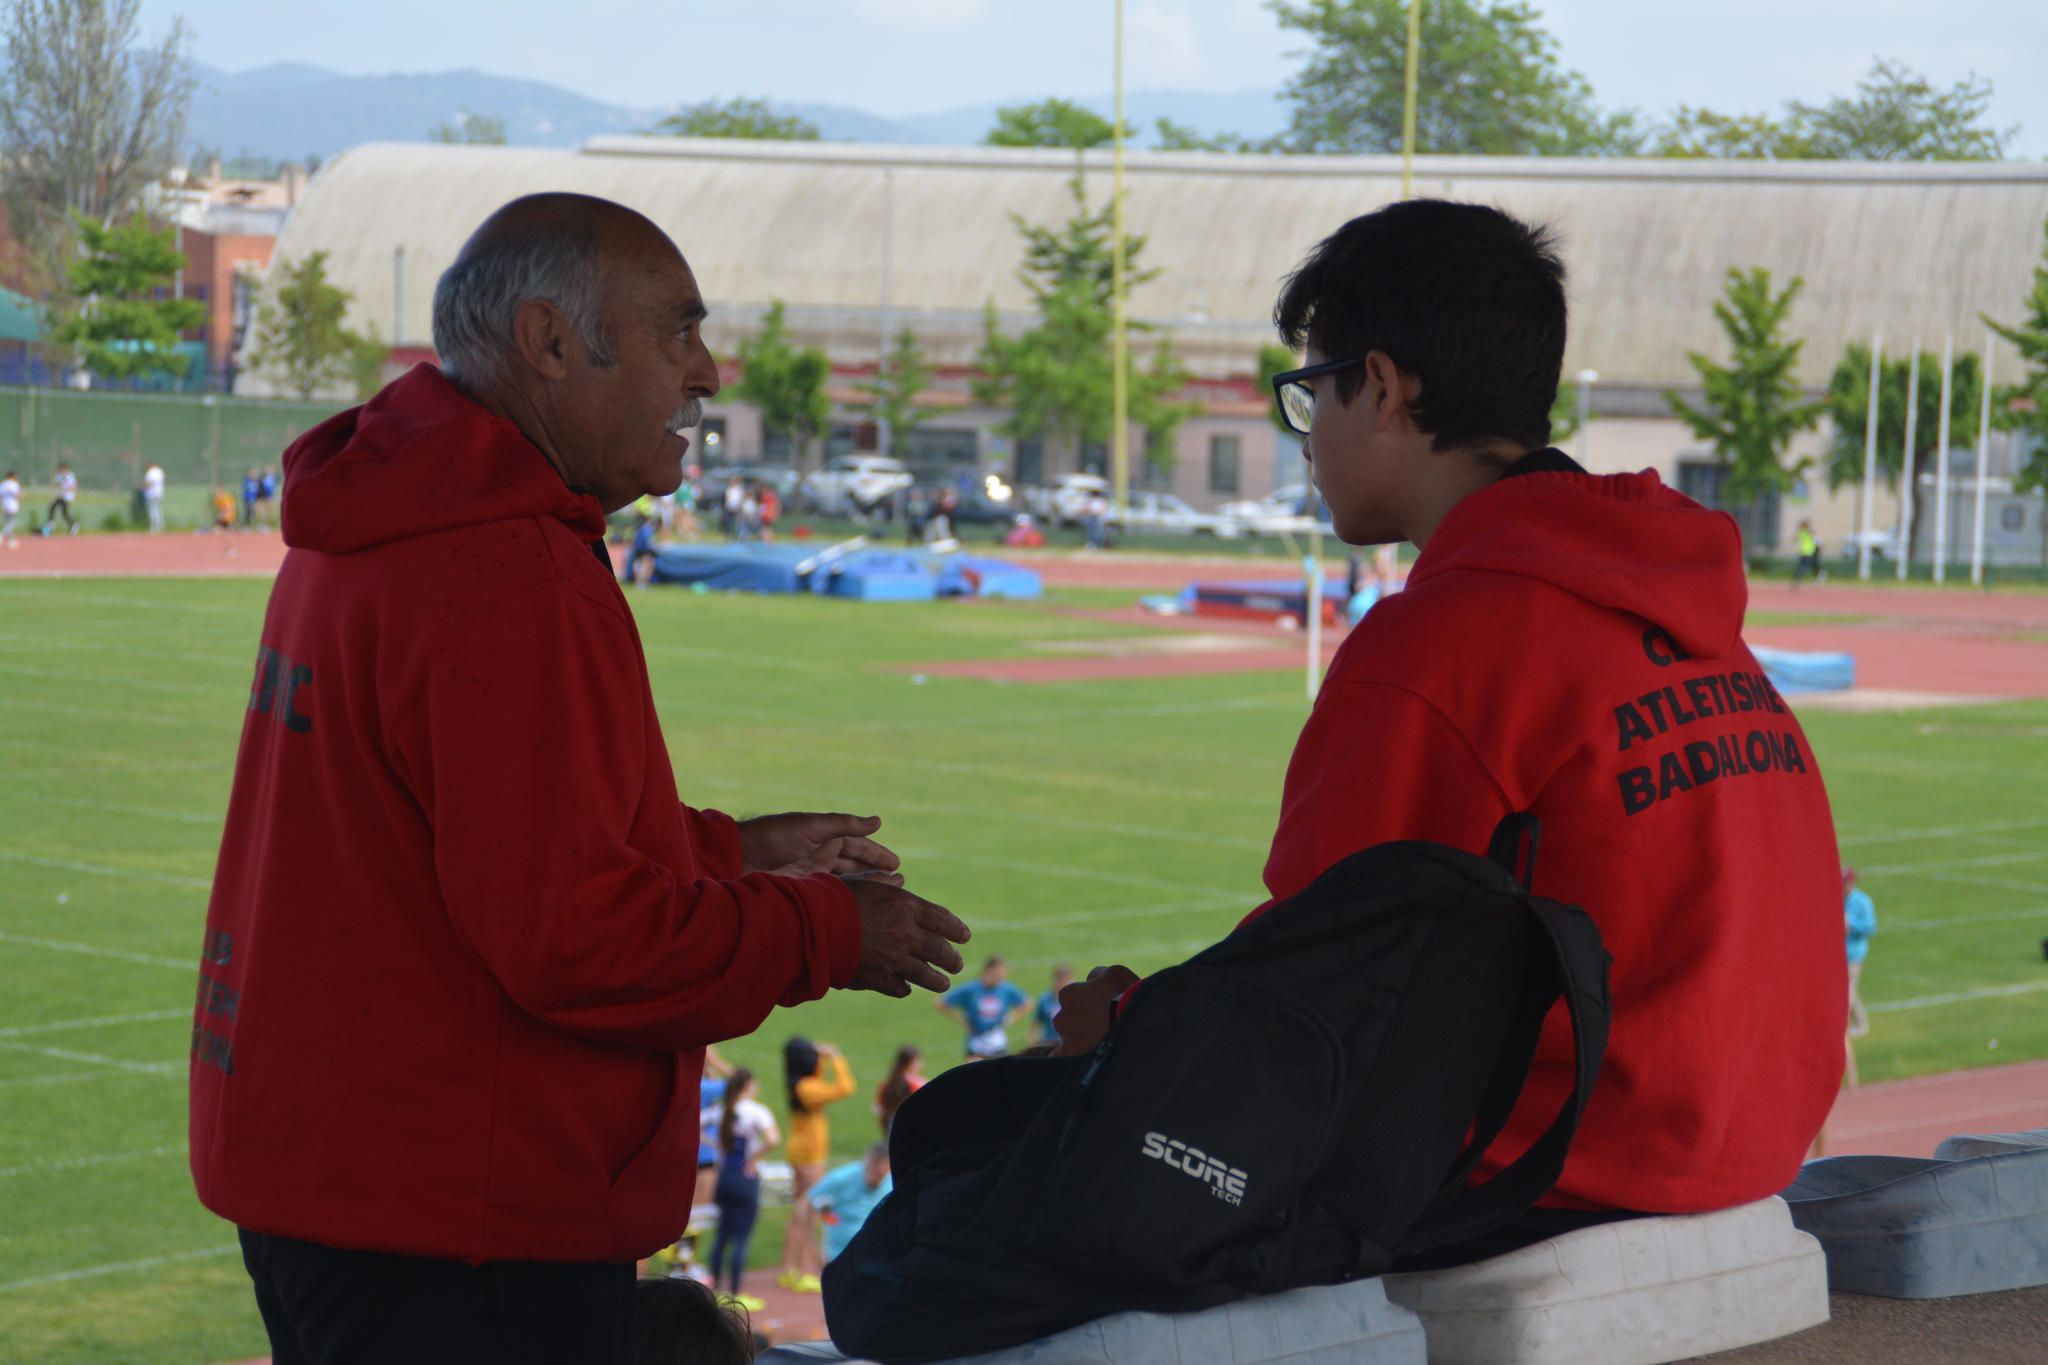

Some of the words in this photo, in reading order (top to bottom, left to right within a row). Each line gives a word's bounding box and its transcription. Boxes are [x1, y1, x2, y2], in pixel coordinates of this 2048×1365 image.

[1614, 671, 1785, 752] ATLETISME
[1617, 730, 1807, 816] BADALONA
[1142, 1132, 1248, 1197] SCORE
[1211, 1185, 1241, 1207] TECH
